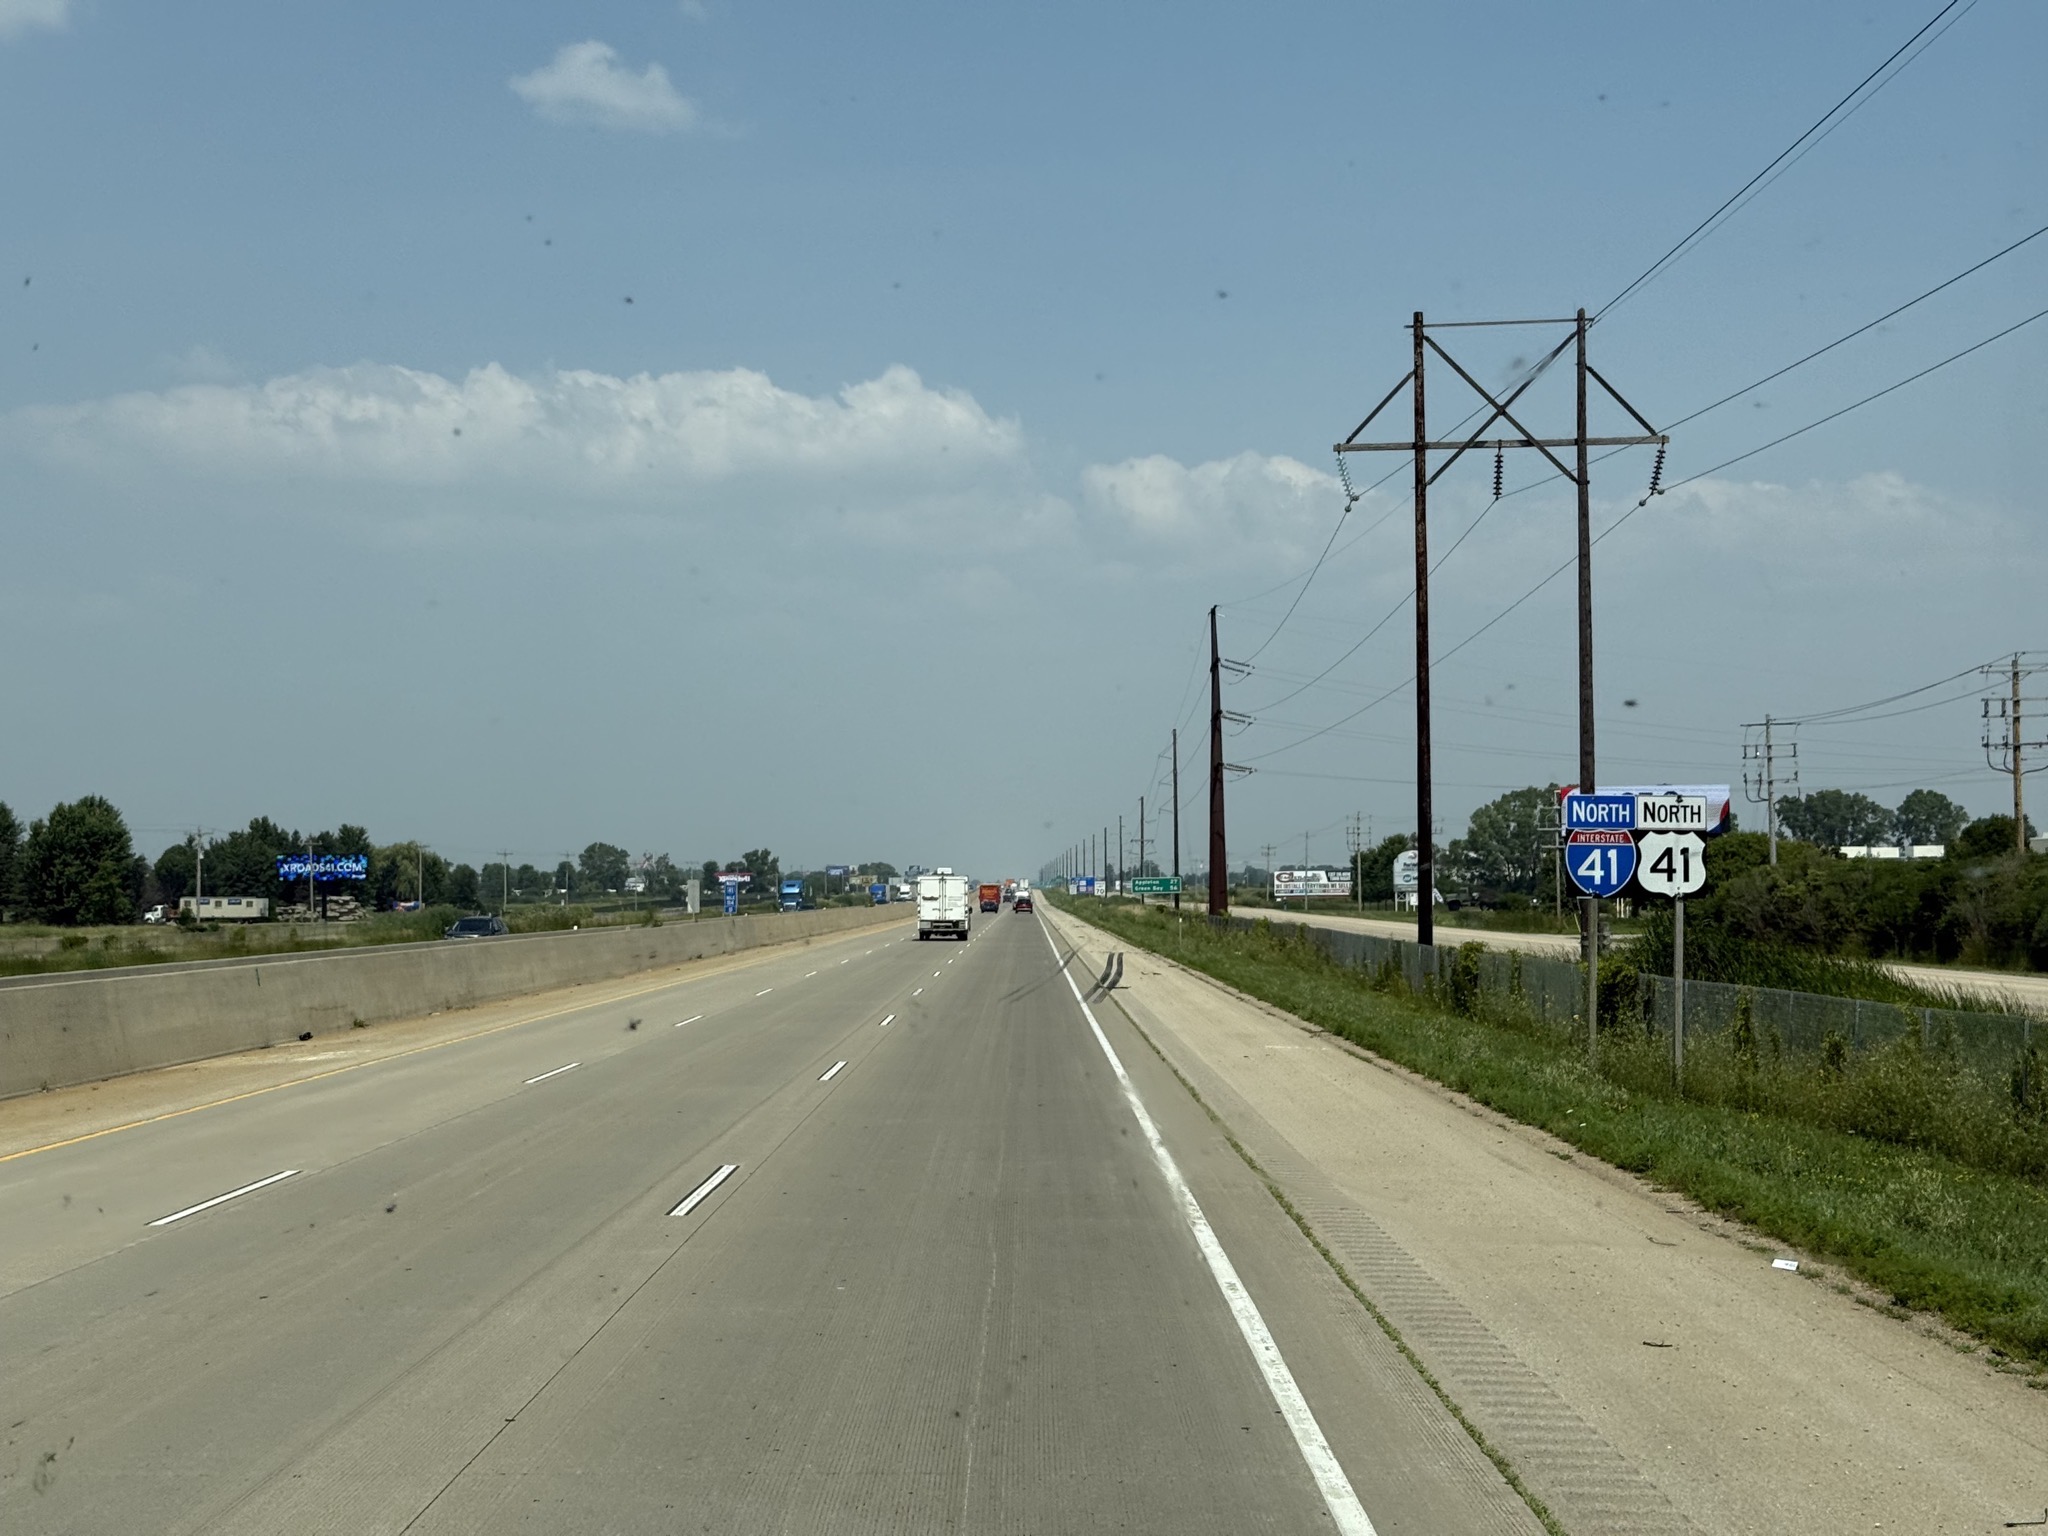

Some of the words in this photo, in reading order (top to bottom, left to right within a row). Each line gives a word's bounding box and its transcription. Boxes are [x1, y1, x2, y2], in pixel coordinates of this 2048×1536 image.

[1572, 801, 1630, 823] NORTH
[1643, 801, 1701, 823] NORTH
[1577, 833, 1624, 843] INTERSTATE
[1577, 848, 1618, 885] 41
[1650, 847, 1690, 883] 41
